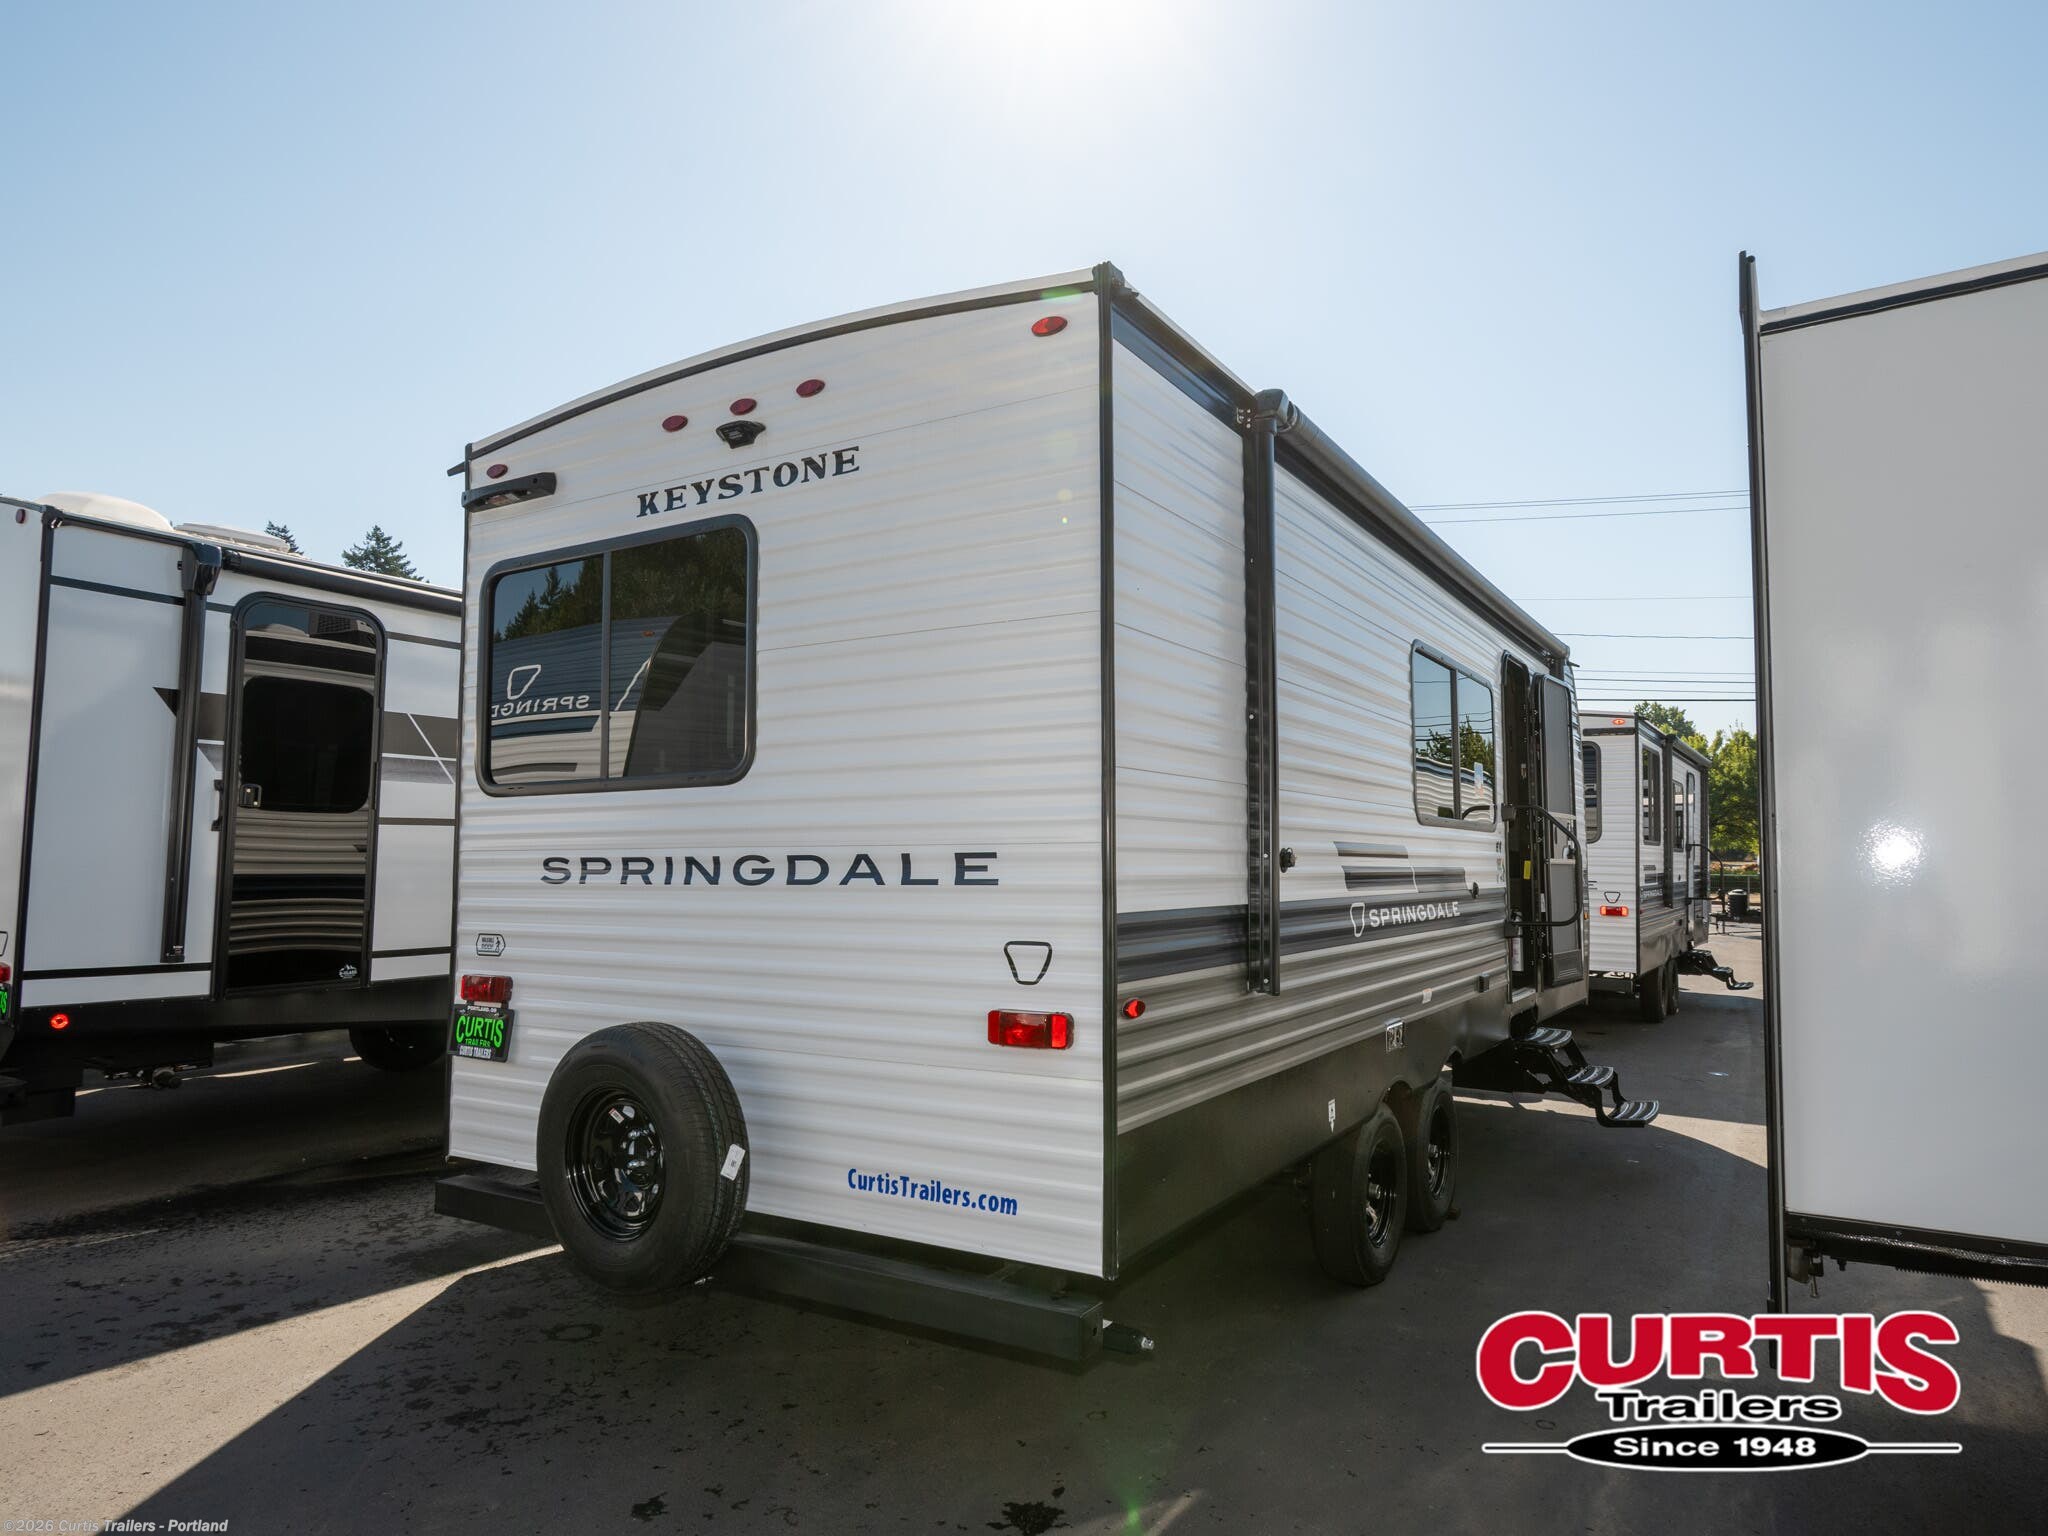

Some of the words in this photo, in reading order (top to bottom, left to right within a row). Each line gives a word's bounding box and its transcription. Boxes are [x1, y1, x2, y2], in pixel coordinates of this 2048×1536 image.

[636, 446, 860, 518] KEYSTONE
[541, 852, 999, 886] SPRINGDALE
[1369, 901, 1460, 928] SPRINGDALE
[455, 1015, 504, 1048] CURTIS
[847, 1168, 1018, 1216] CurtisTrailers.com
